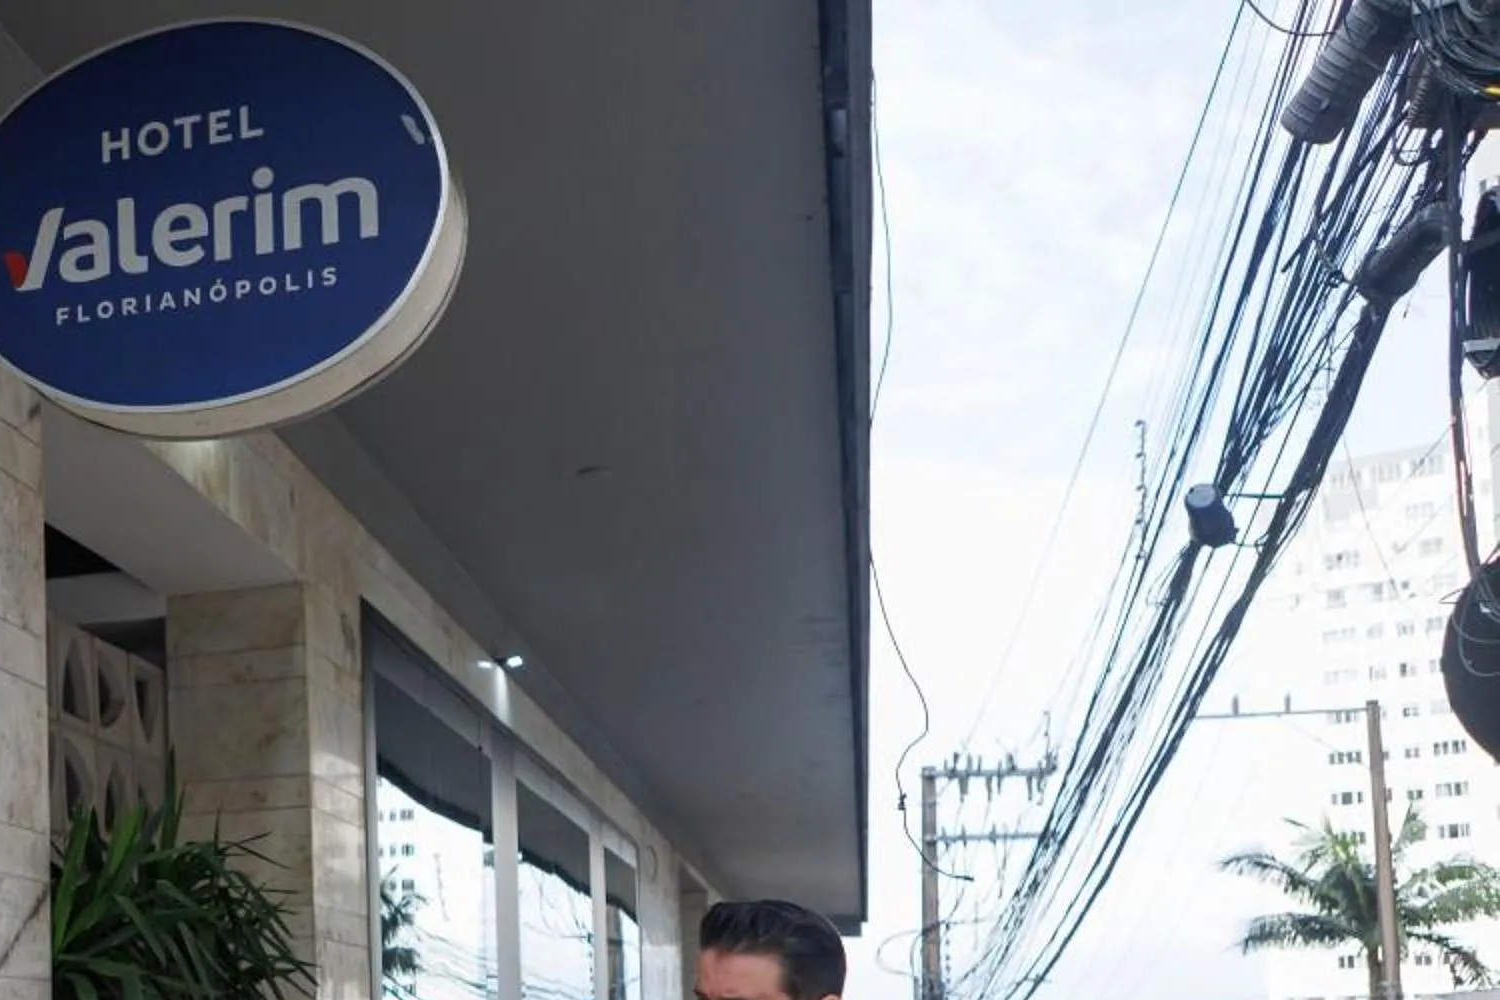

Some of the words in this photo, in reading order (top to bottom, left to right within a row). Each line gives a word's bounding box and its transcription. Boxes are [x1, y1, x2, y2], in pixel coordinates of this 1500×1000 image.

[100, 105, 265, 164] HOTEL
[4, 166, 380, 292] Valerim
[55, 266, 339, 326] FLORIANÓPOLIS
